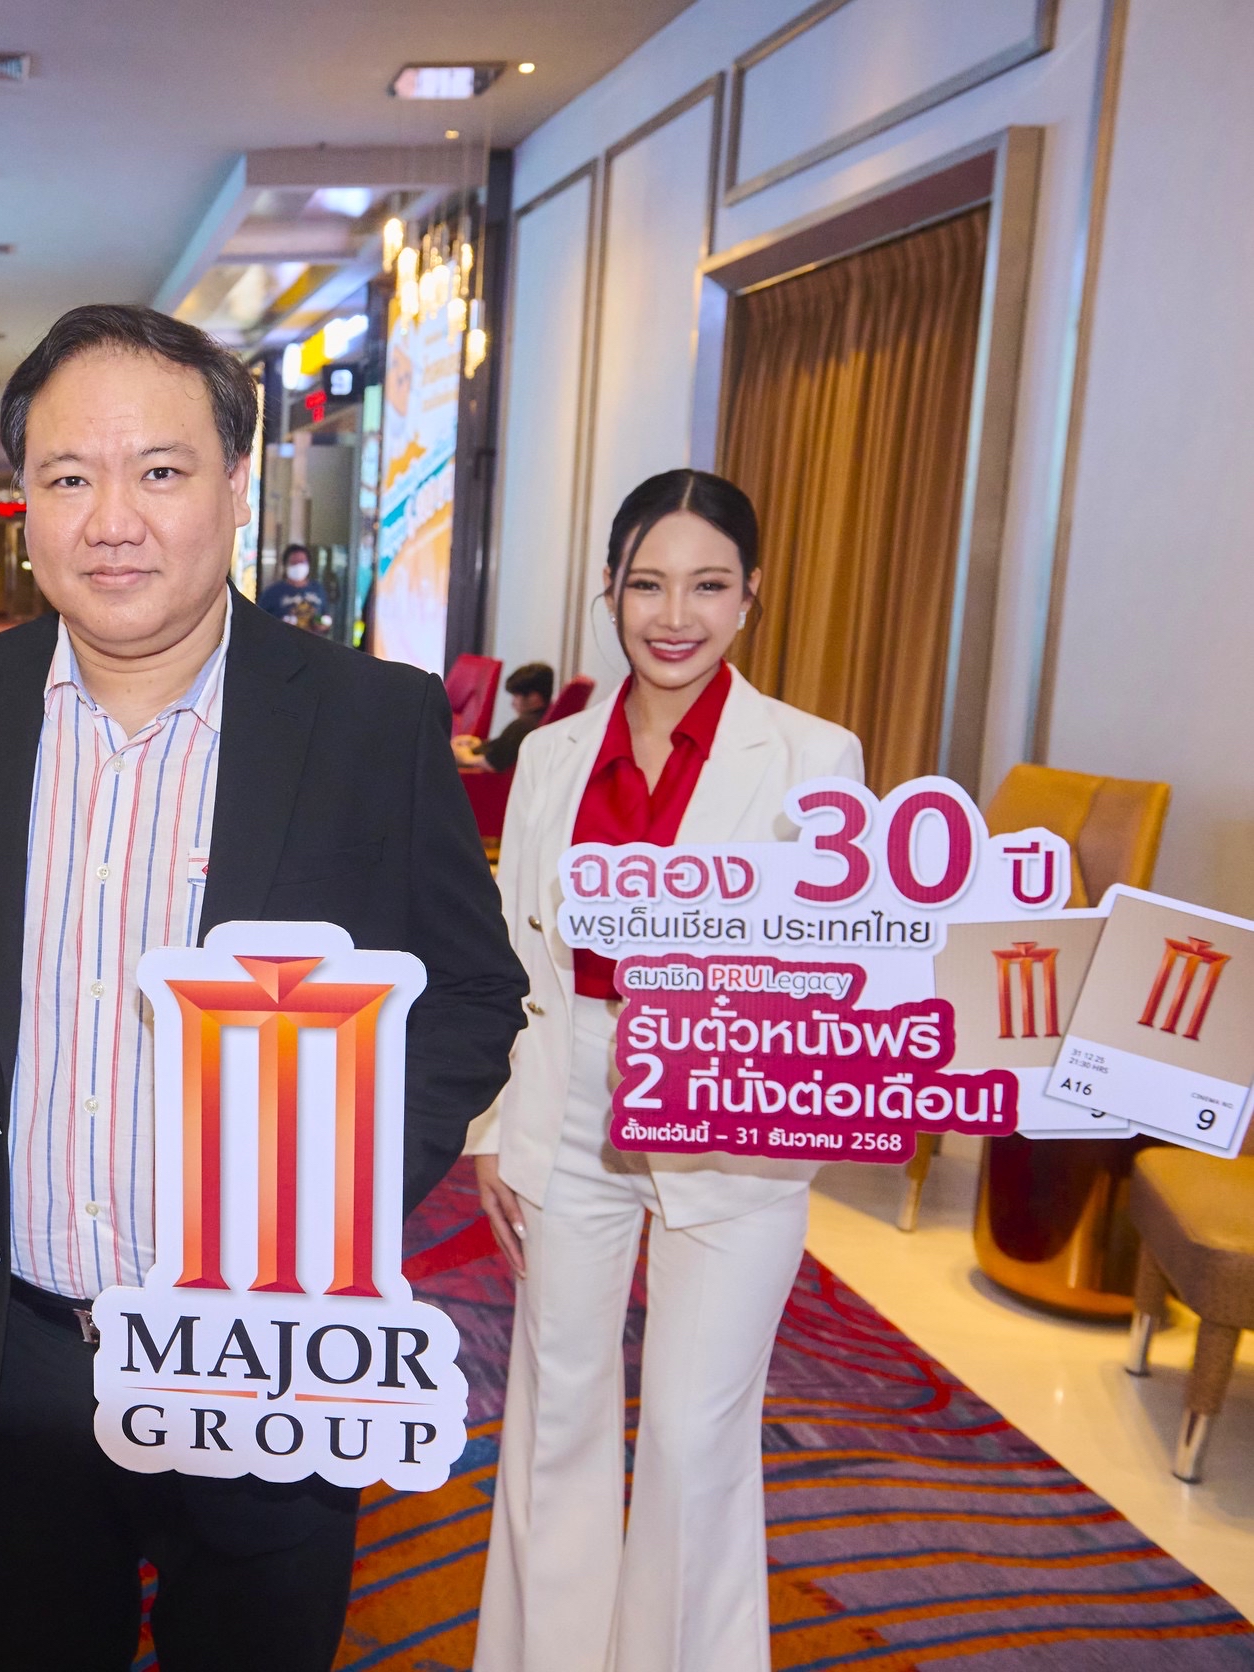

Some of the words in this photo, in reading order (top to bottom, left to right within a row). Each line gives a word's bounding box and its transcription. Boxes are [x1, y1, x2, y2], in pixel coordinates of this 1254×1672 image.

[569, 853, 755, 900] ฉลอง
[793, 791, 973, 904] 30
[1003, 841, 1055, 904] ปี
[569, 906, 747, 945] พรูเด็นเชียล
[762, 911, 931, 944] ประเทศไทย
[625, 965, 700, 990] สมาชิก
[710, 969, 852, 997] PRULegacy
[627, 994, 941, 1060] รับตั๋วหนังฟรี
[623, 1053, 663, 1110] 2
[688, 1059, 1004, 1123] ที่นั่งต่อเดือน!
[1060, 1077, 1093, 1096] A16
[621, 1117, 710, 1144] ตั้งแต่วันนี้
[736, 1127, 759, 1145] 31
[768, 1127, 843, 1150] ธันวาคม
[851, 1132, 903, 1152] 2568
[1196, 1108, 1216, 1131] 9
[119, 1311, 438, 1401] MAJOR
[121, 1403, 437, 1464] GROUP
